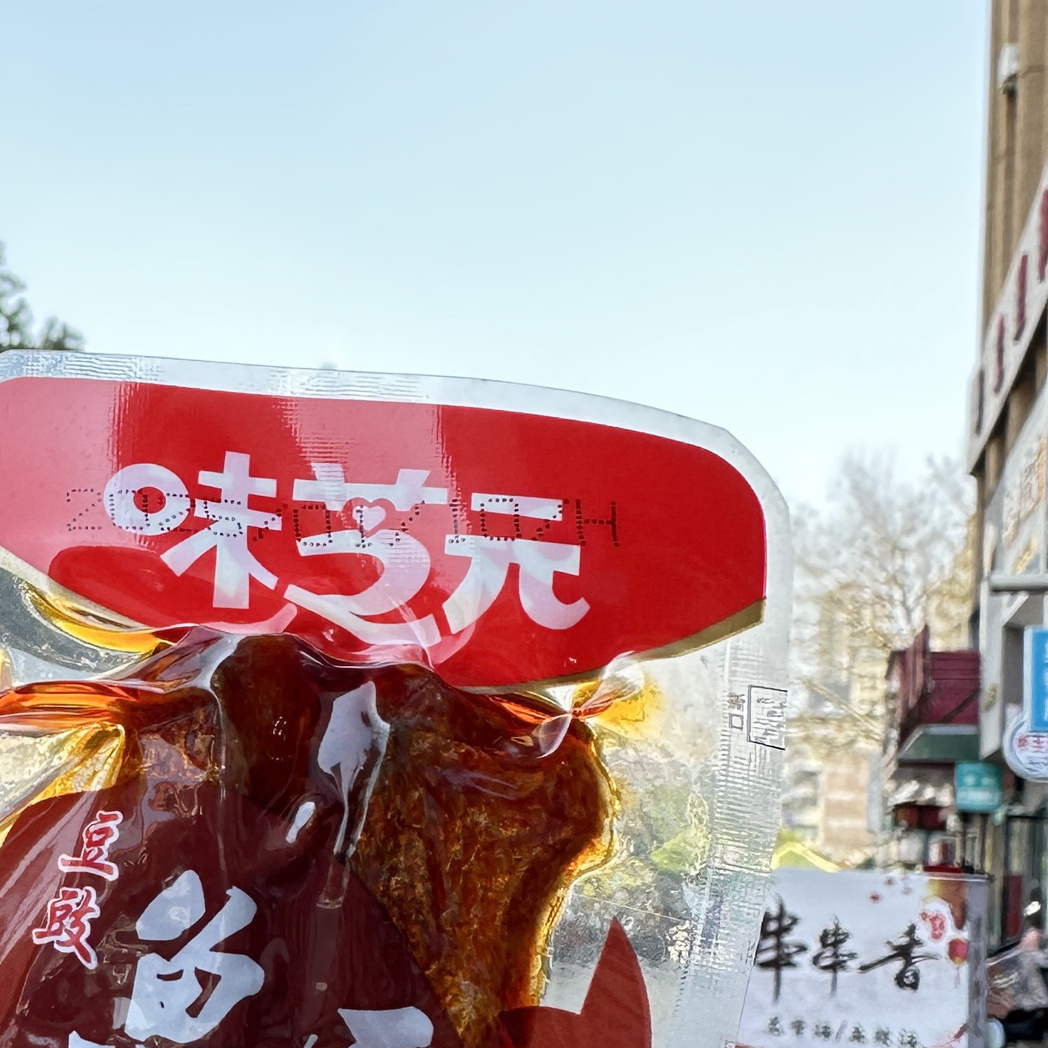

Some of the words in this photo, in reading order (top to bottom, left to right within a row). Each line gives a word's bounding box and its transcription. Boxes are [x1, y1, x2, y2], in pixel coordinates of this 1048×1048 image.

[104, 451, 591, 646] 味芝元
[32, 811, 124, 970] 豆豉
[755, 892, 940, 1006] 串串香
